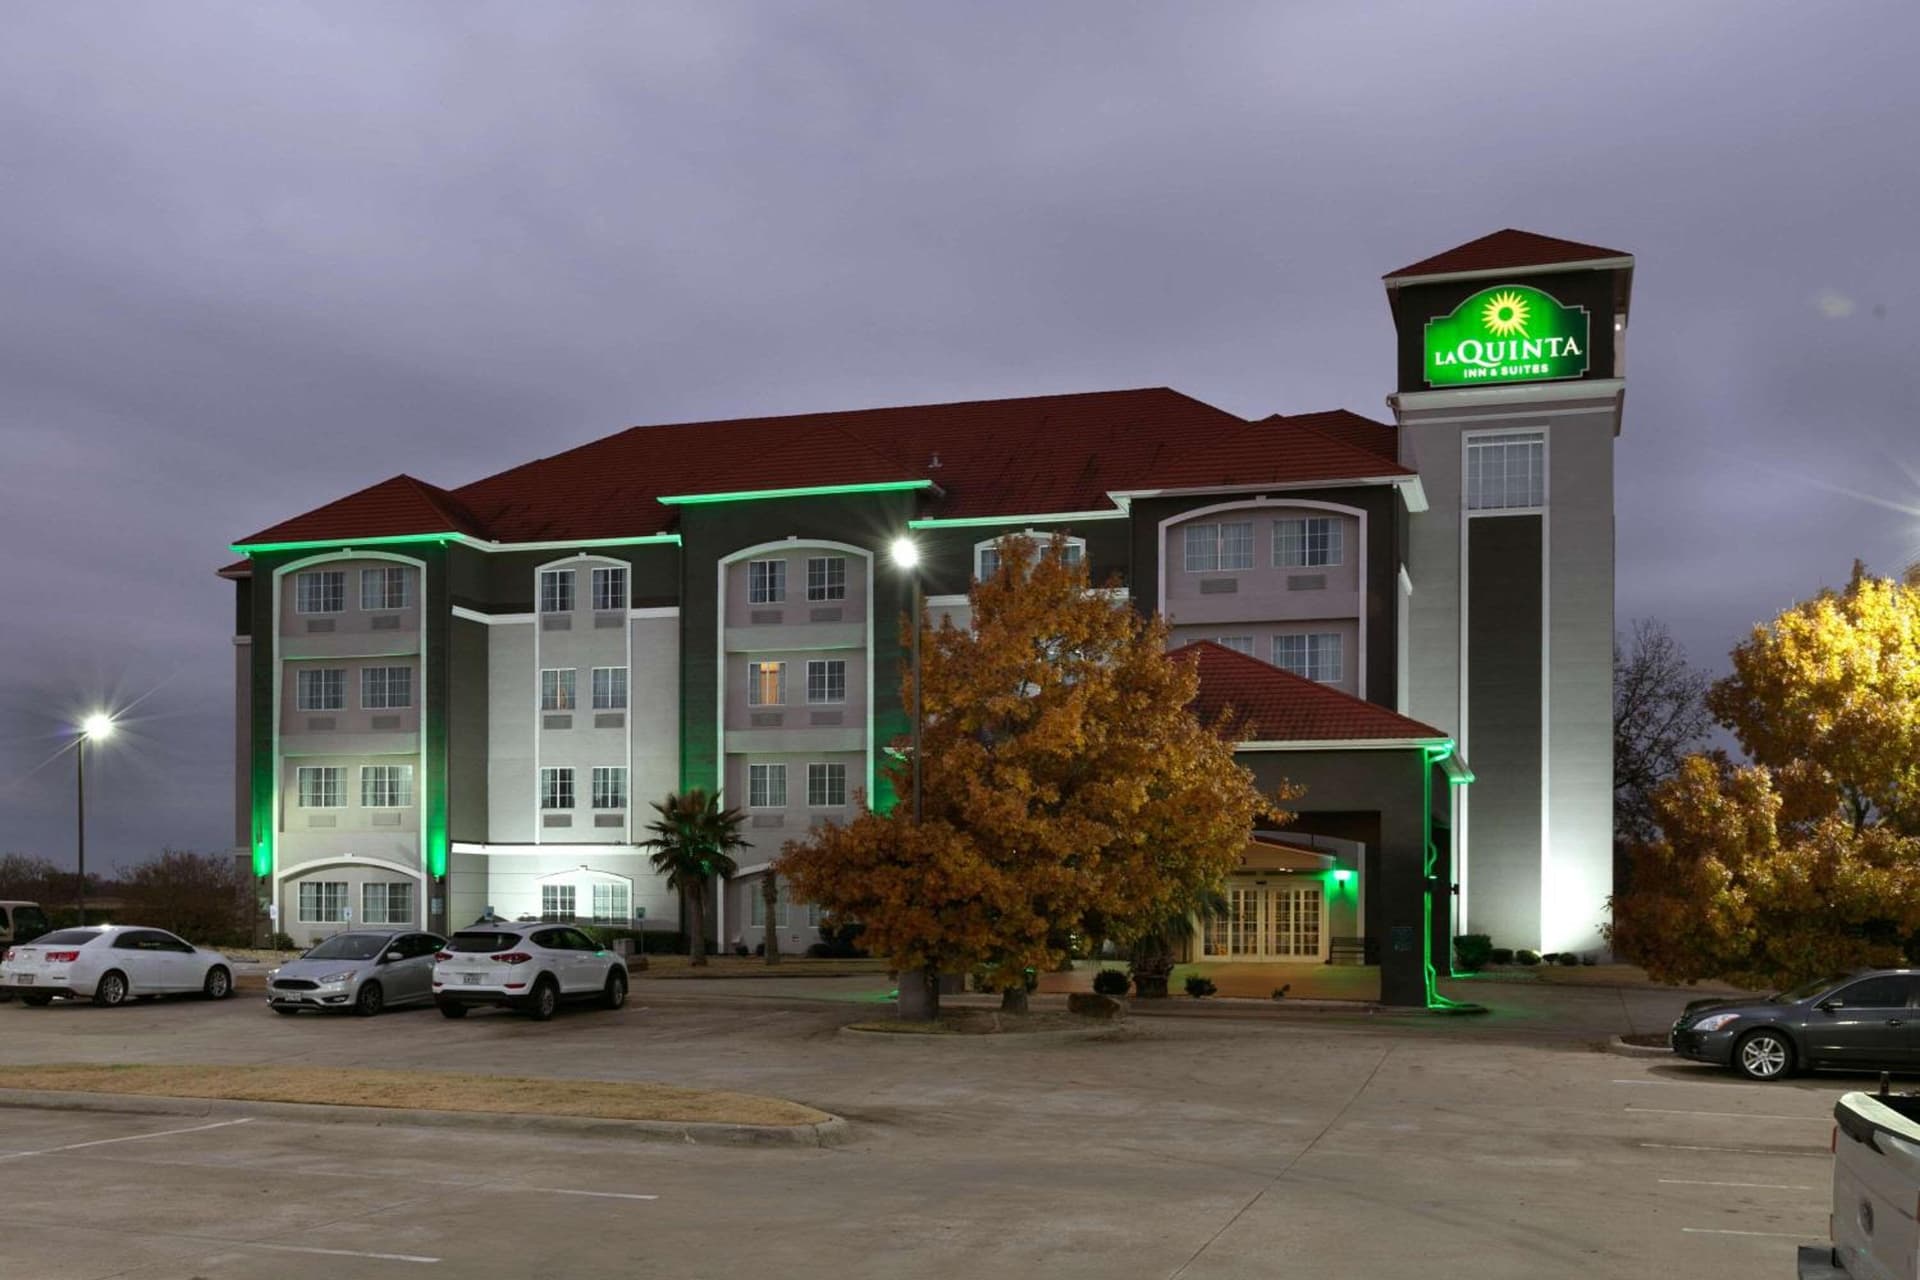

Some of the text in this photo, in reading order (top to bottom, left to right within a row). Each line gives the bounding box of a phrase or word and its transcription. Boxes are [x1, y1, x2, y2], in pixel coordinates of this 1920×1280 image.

[1435, 336, 1581, 367] LA QUINTA
[1463, 364, 1549, 378] INN & SUITES
